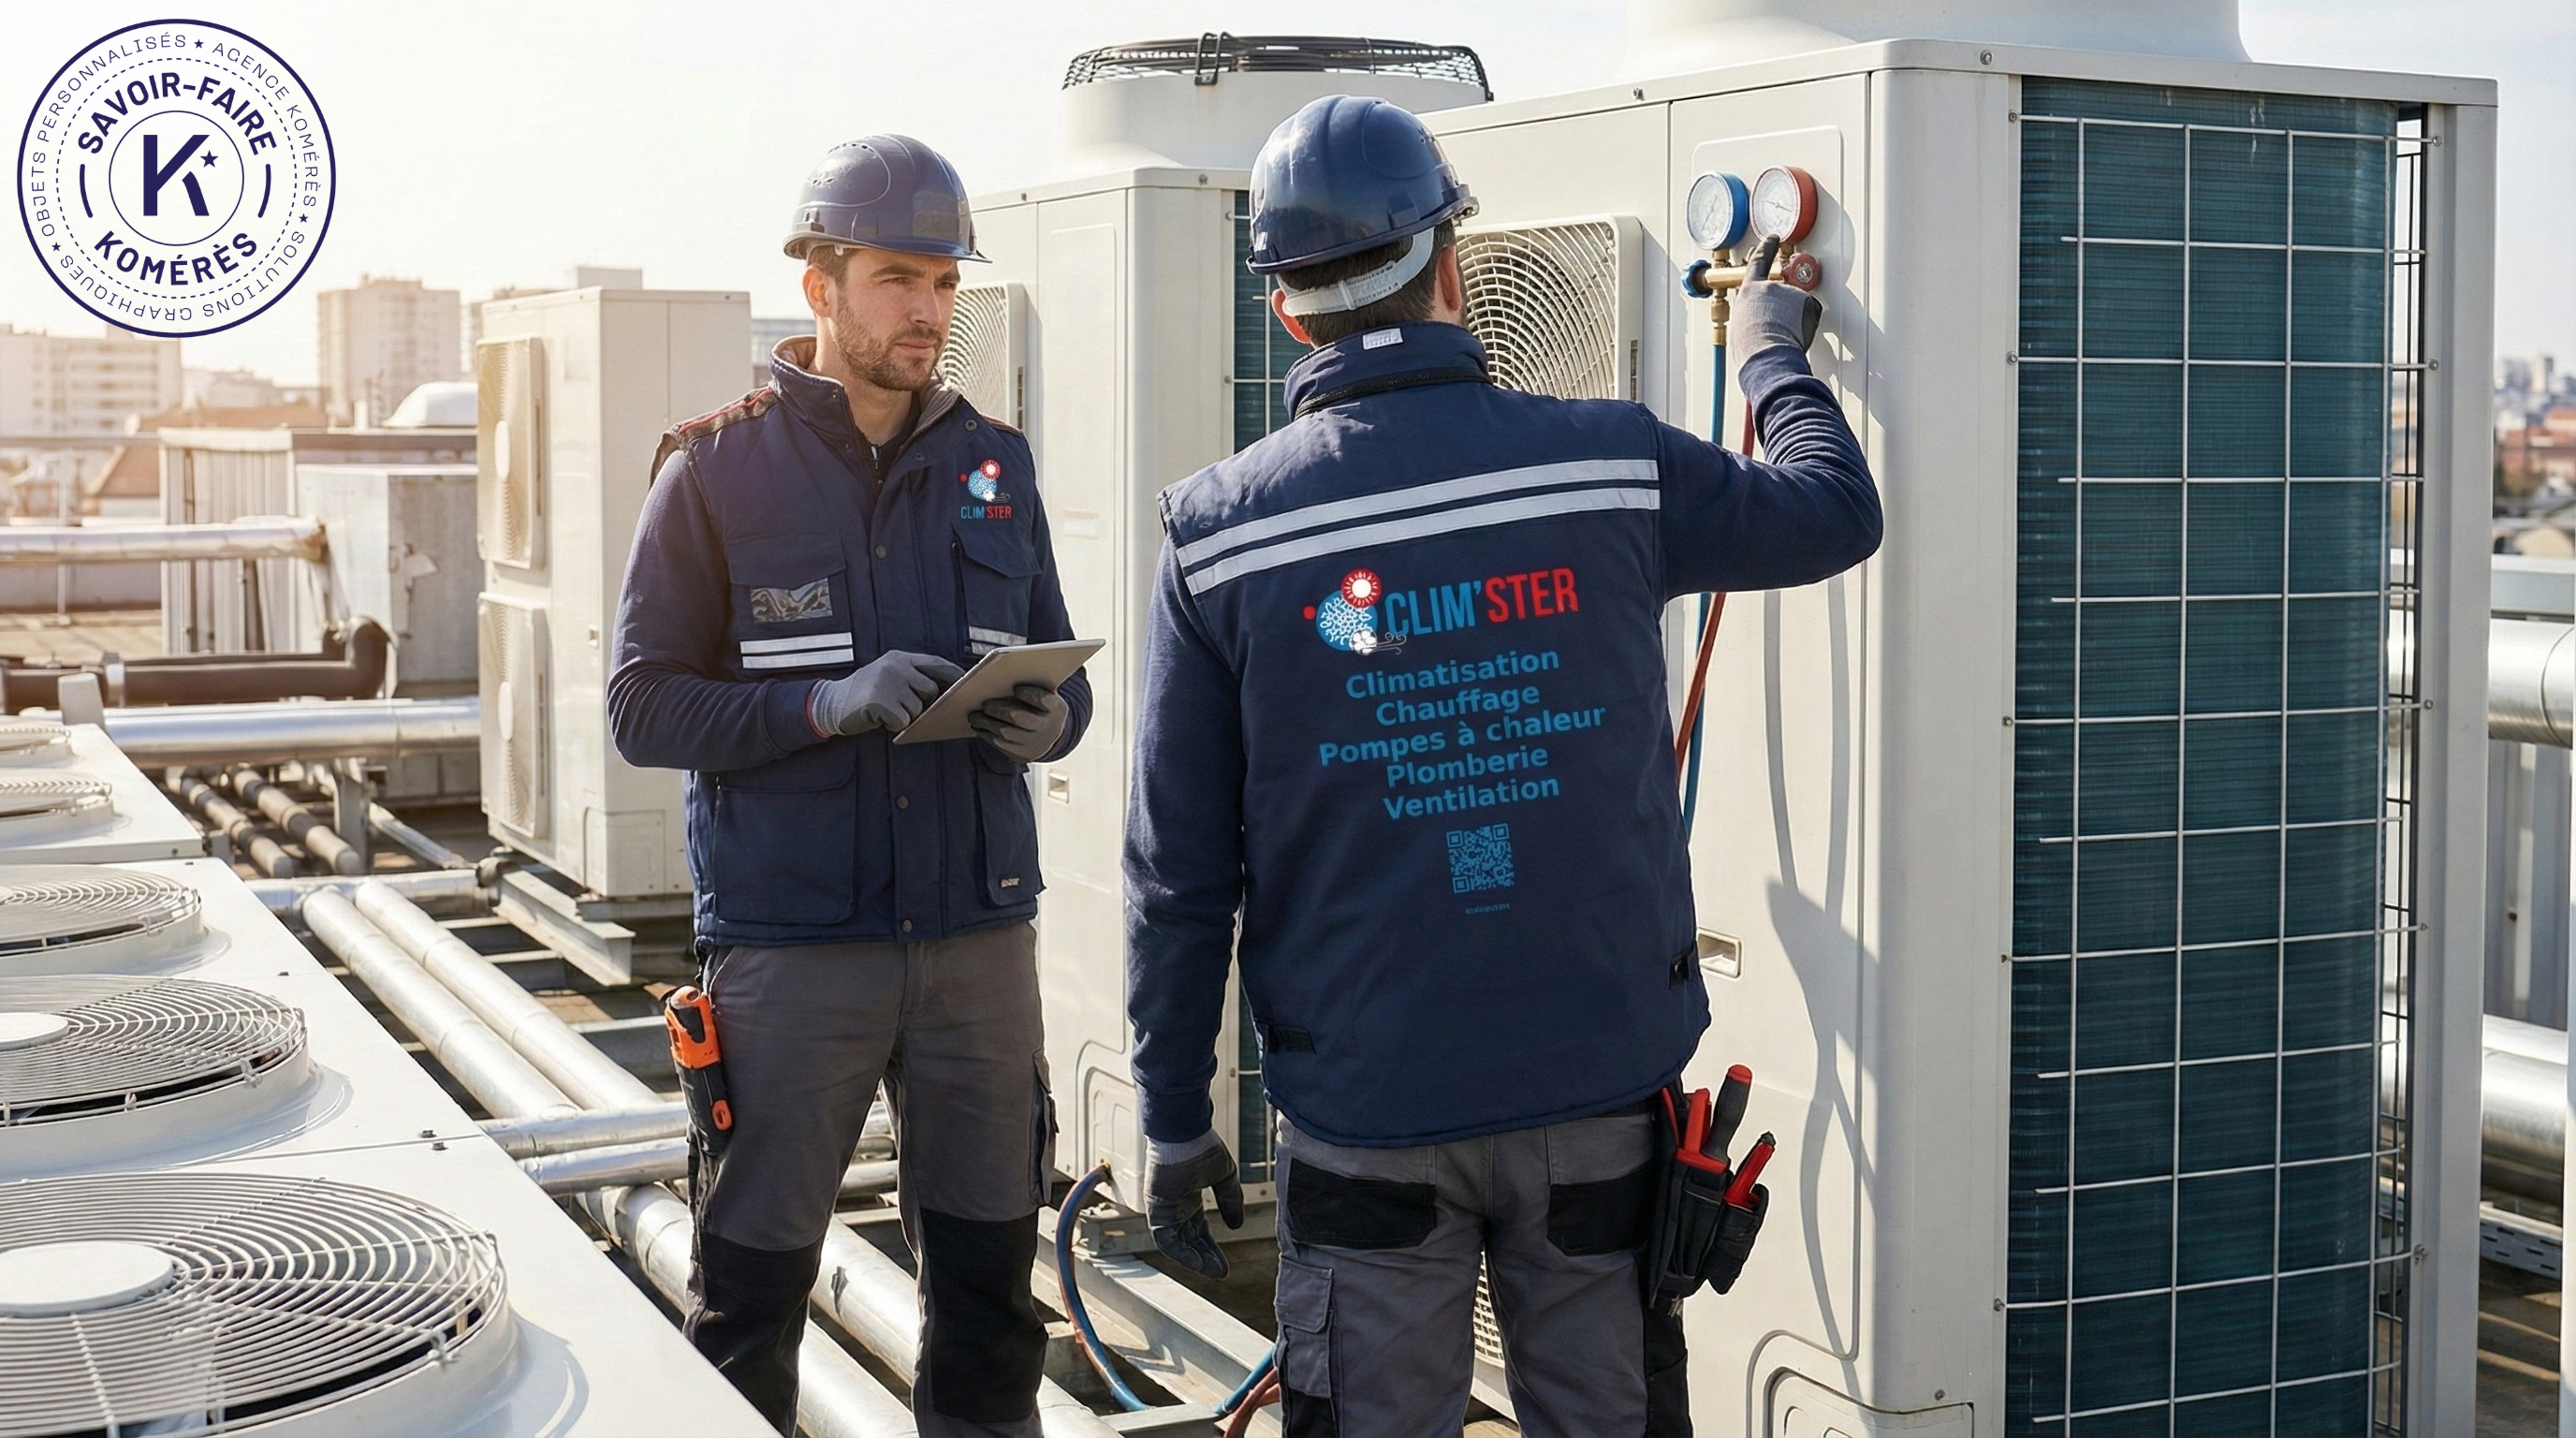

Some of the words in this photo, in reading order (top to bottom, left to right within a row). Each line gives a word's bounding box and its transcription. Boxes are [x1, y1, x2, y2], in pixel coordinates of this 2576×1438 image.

[1384, 567, 1579, 636] CLIM'STER
[1346, 651, 1559, 698] Climatisation
[1376, 685, 1540, 726] Chauffage
[1319, 731, 1445, 767] Pompes
[1457, 721, 1475, 746] à
[1486, 707, 1606, 742] chaleur
[1386, 746, 1548, 788] Plomberie
[1383, 778, 1559, 819] Ventilation
